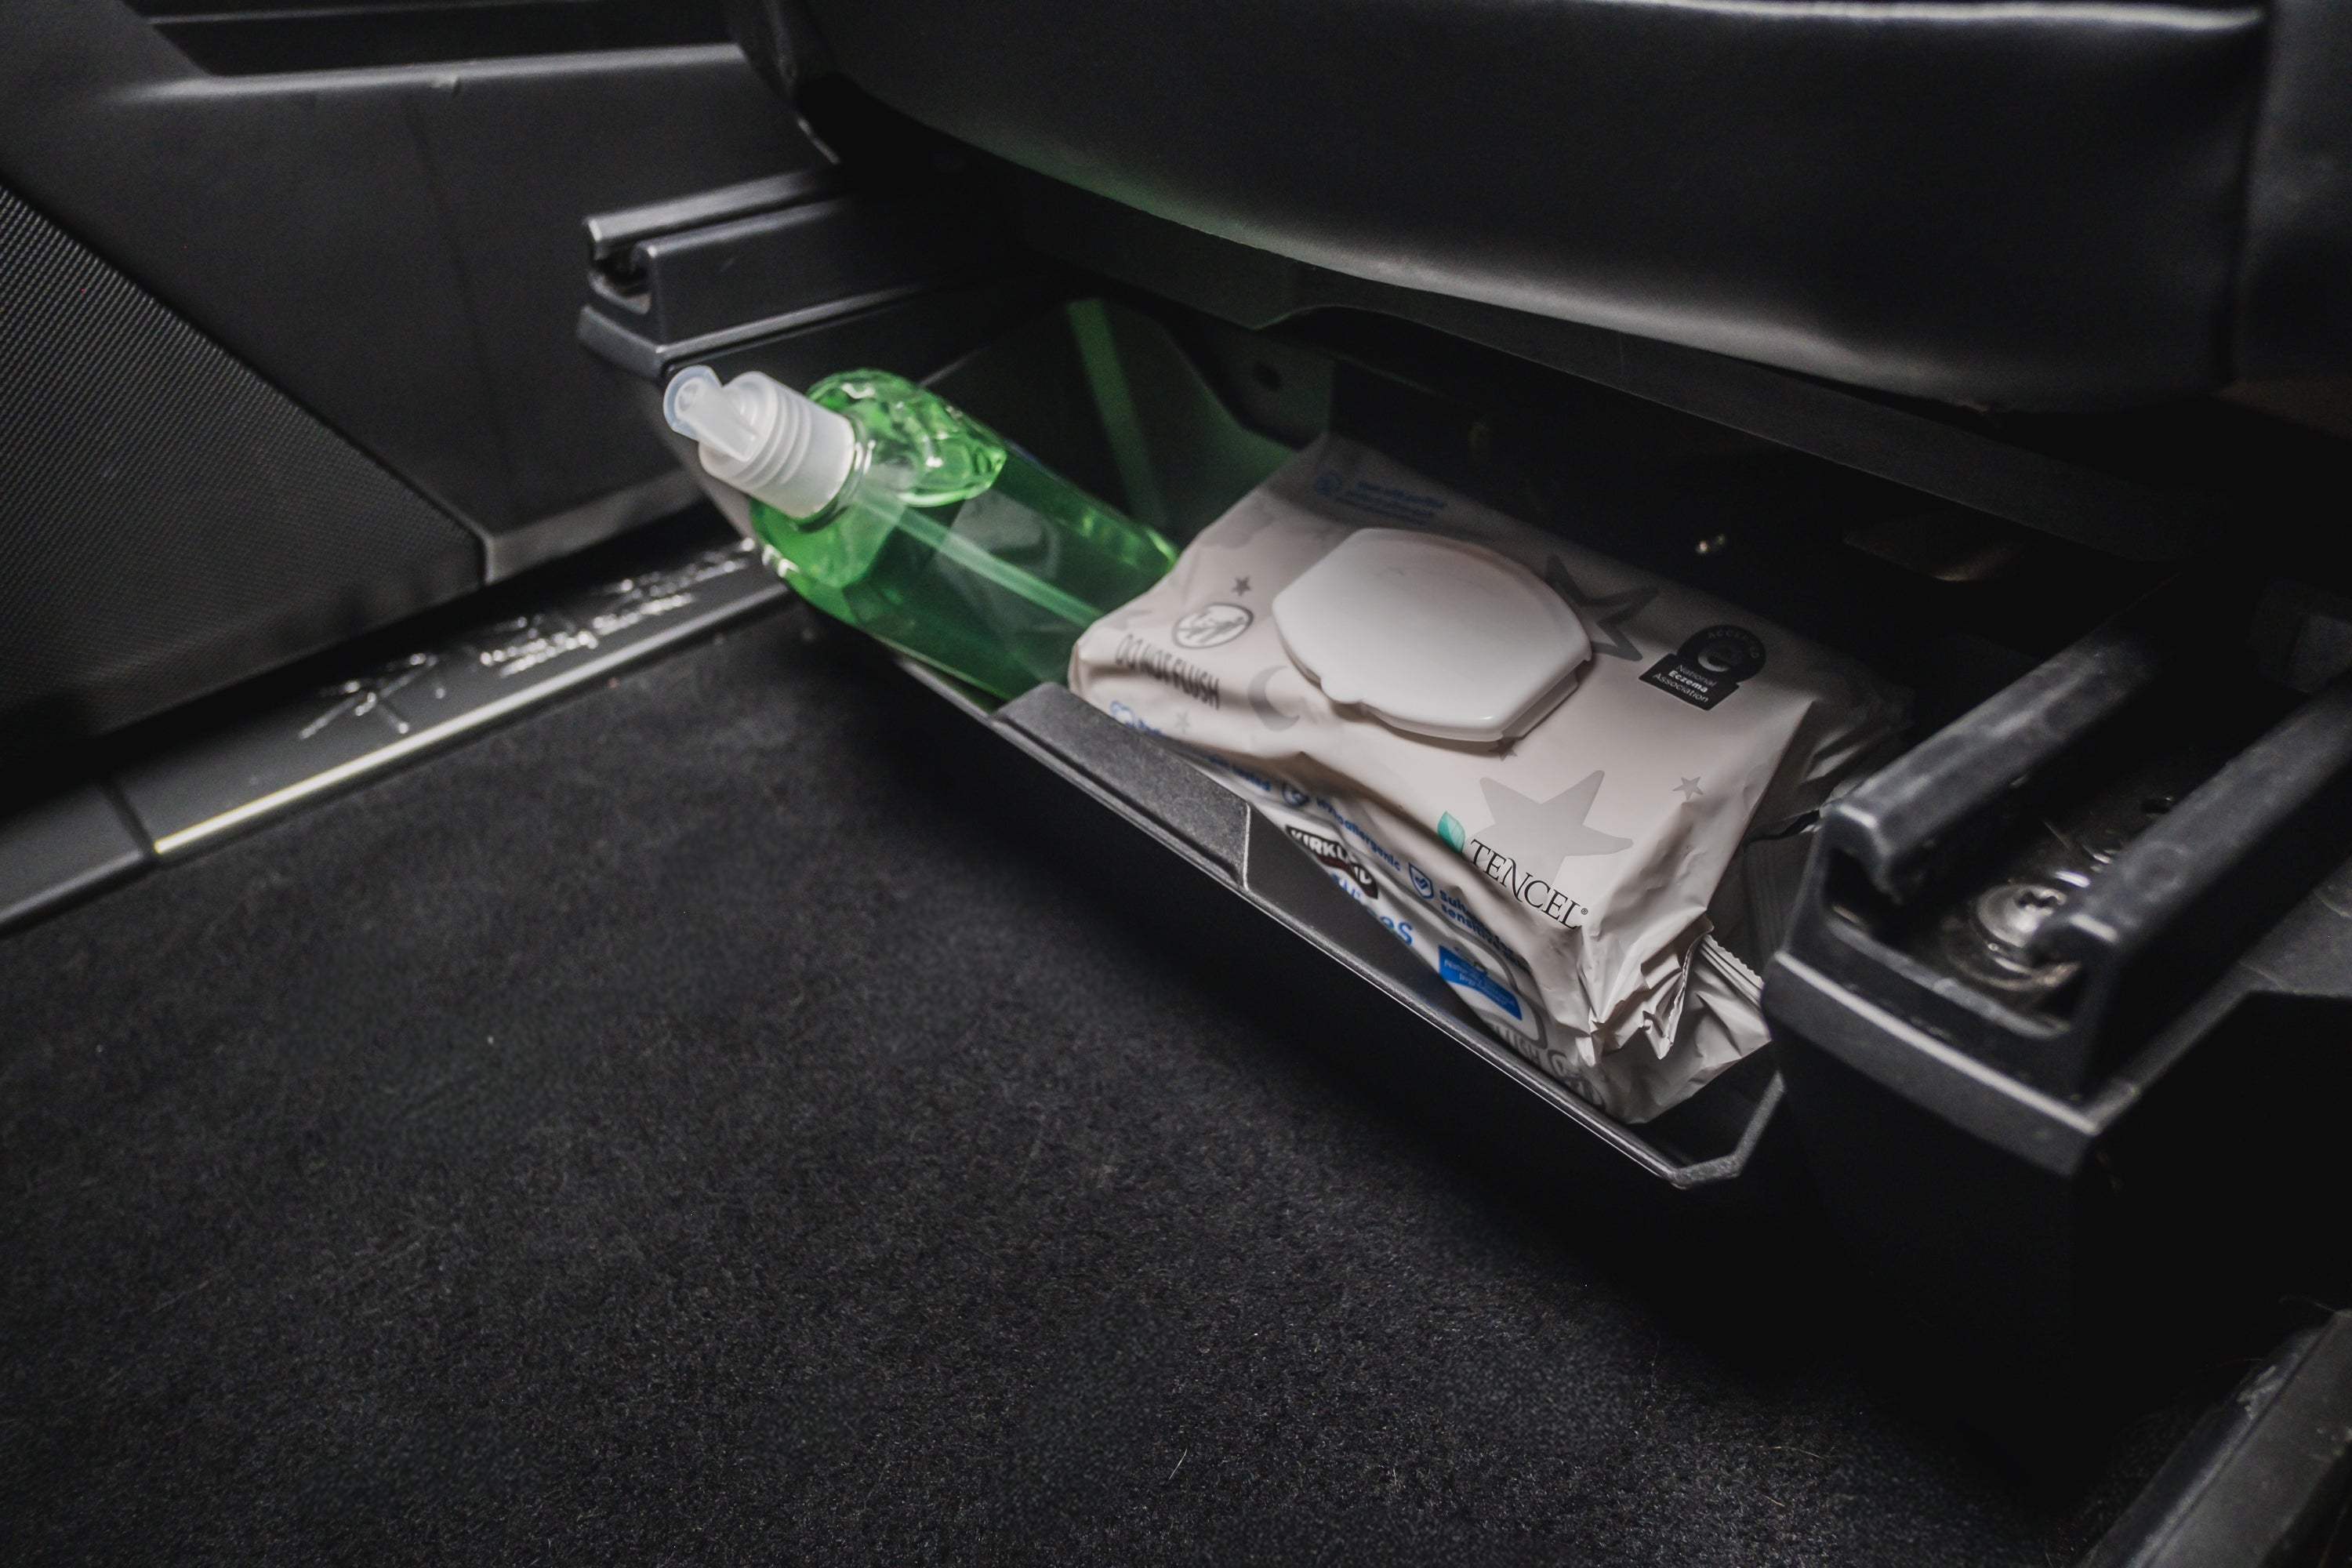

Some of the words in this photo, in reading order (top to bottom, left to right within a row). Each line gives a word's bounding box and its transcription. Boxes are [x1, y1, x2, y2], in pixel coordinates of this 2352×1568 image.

[1173, 658, 1220, 710] FLUSH
[1653, 673, 1709, 702] Association
[1668, 670, 1708, 693] Eczema
[1676, 664, 1718, 687] National
